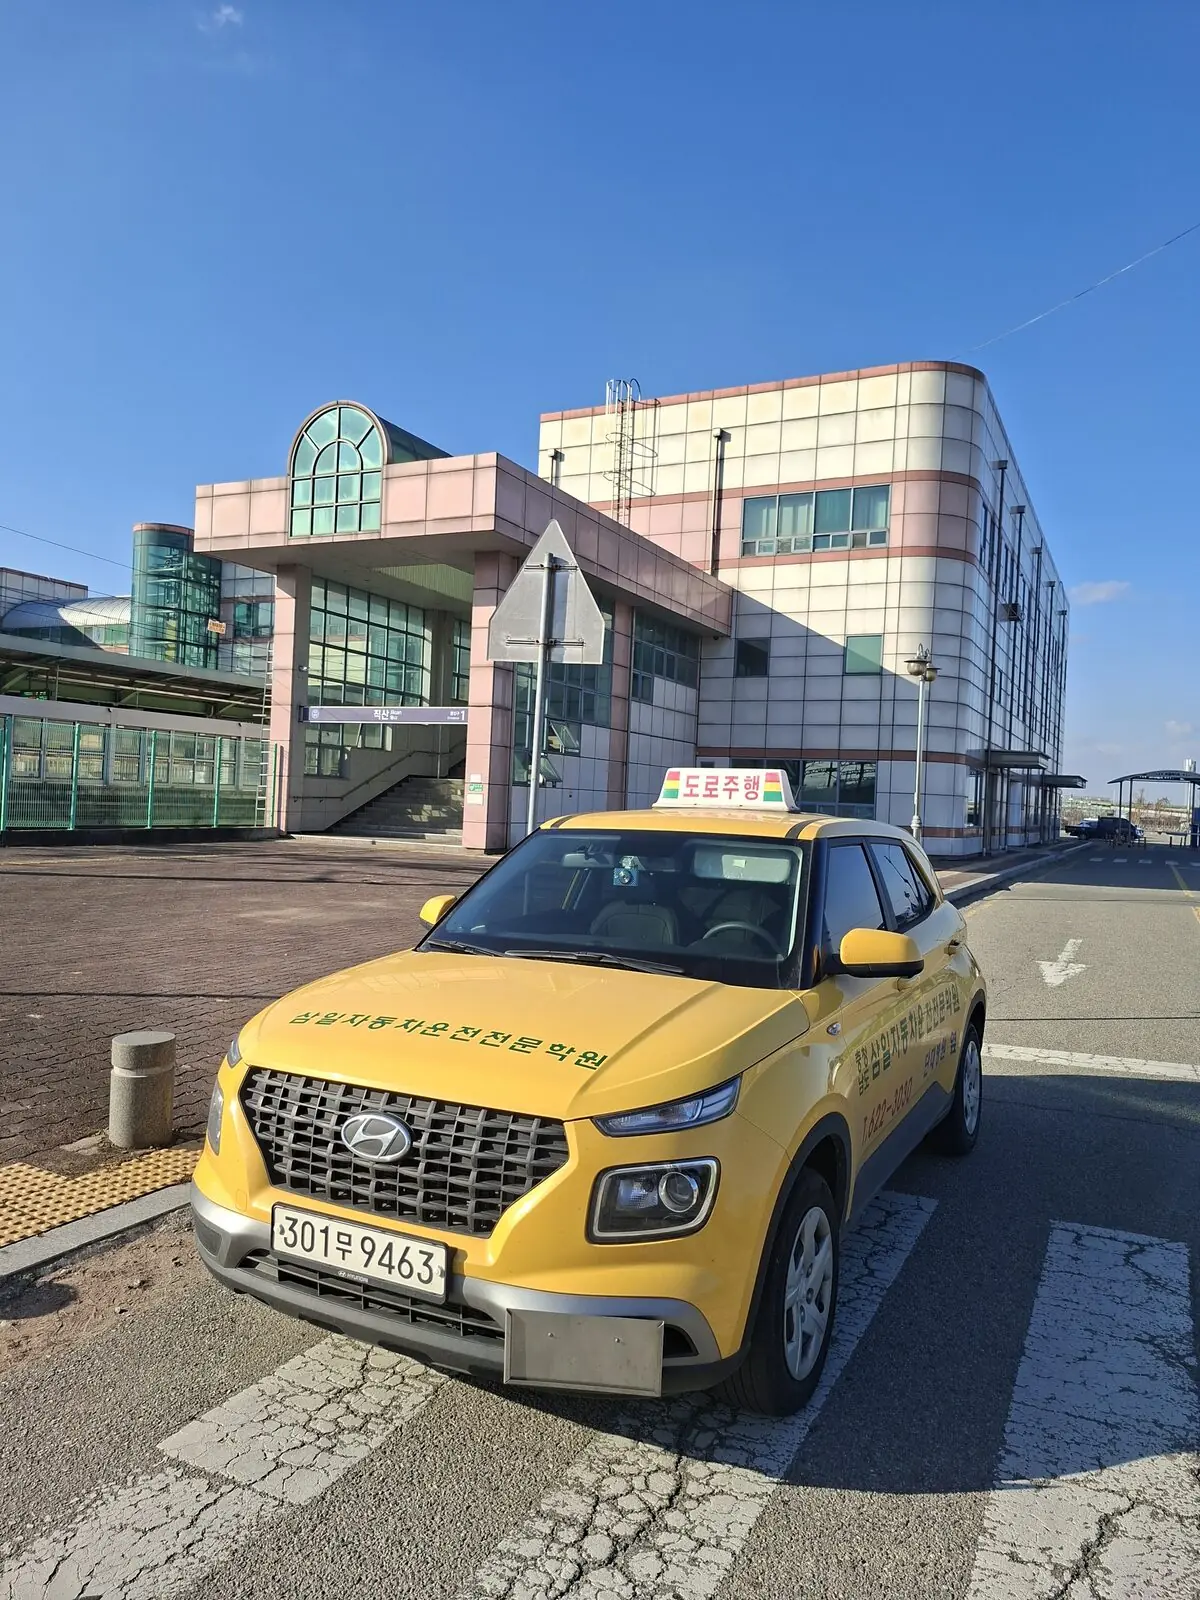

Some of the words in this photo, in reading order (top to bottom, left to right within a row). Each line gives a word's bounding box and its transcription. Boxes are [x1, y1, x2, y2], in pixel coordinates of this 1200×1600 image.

[373, 709, 389, 720] 직산
[460, 710, 465, 720] 1
[683, 775, 760, 800] 도로주행
[289, 1011, 607, 1071] 삼일자동차운전전문학원
